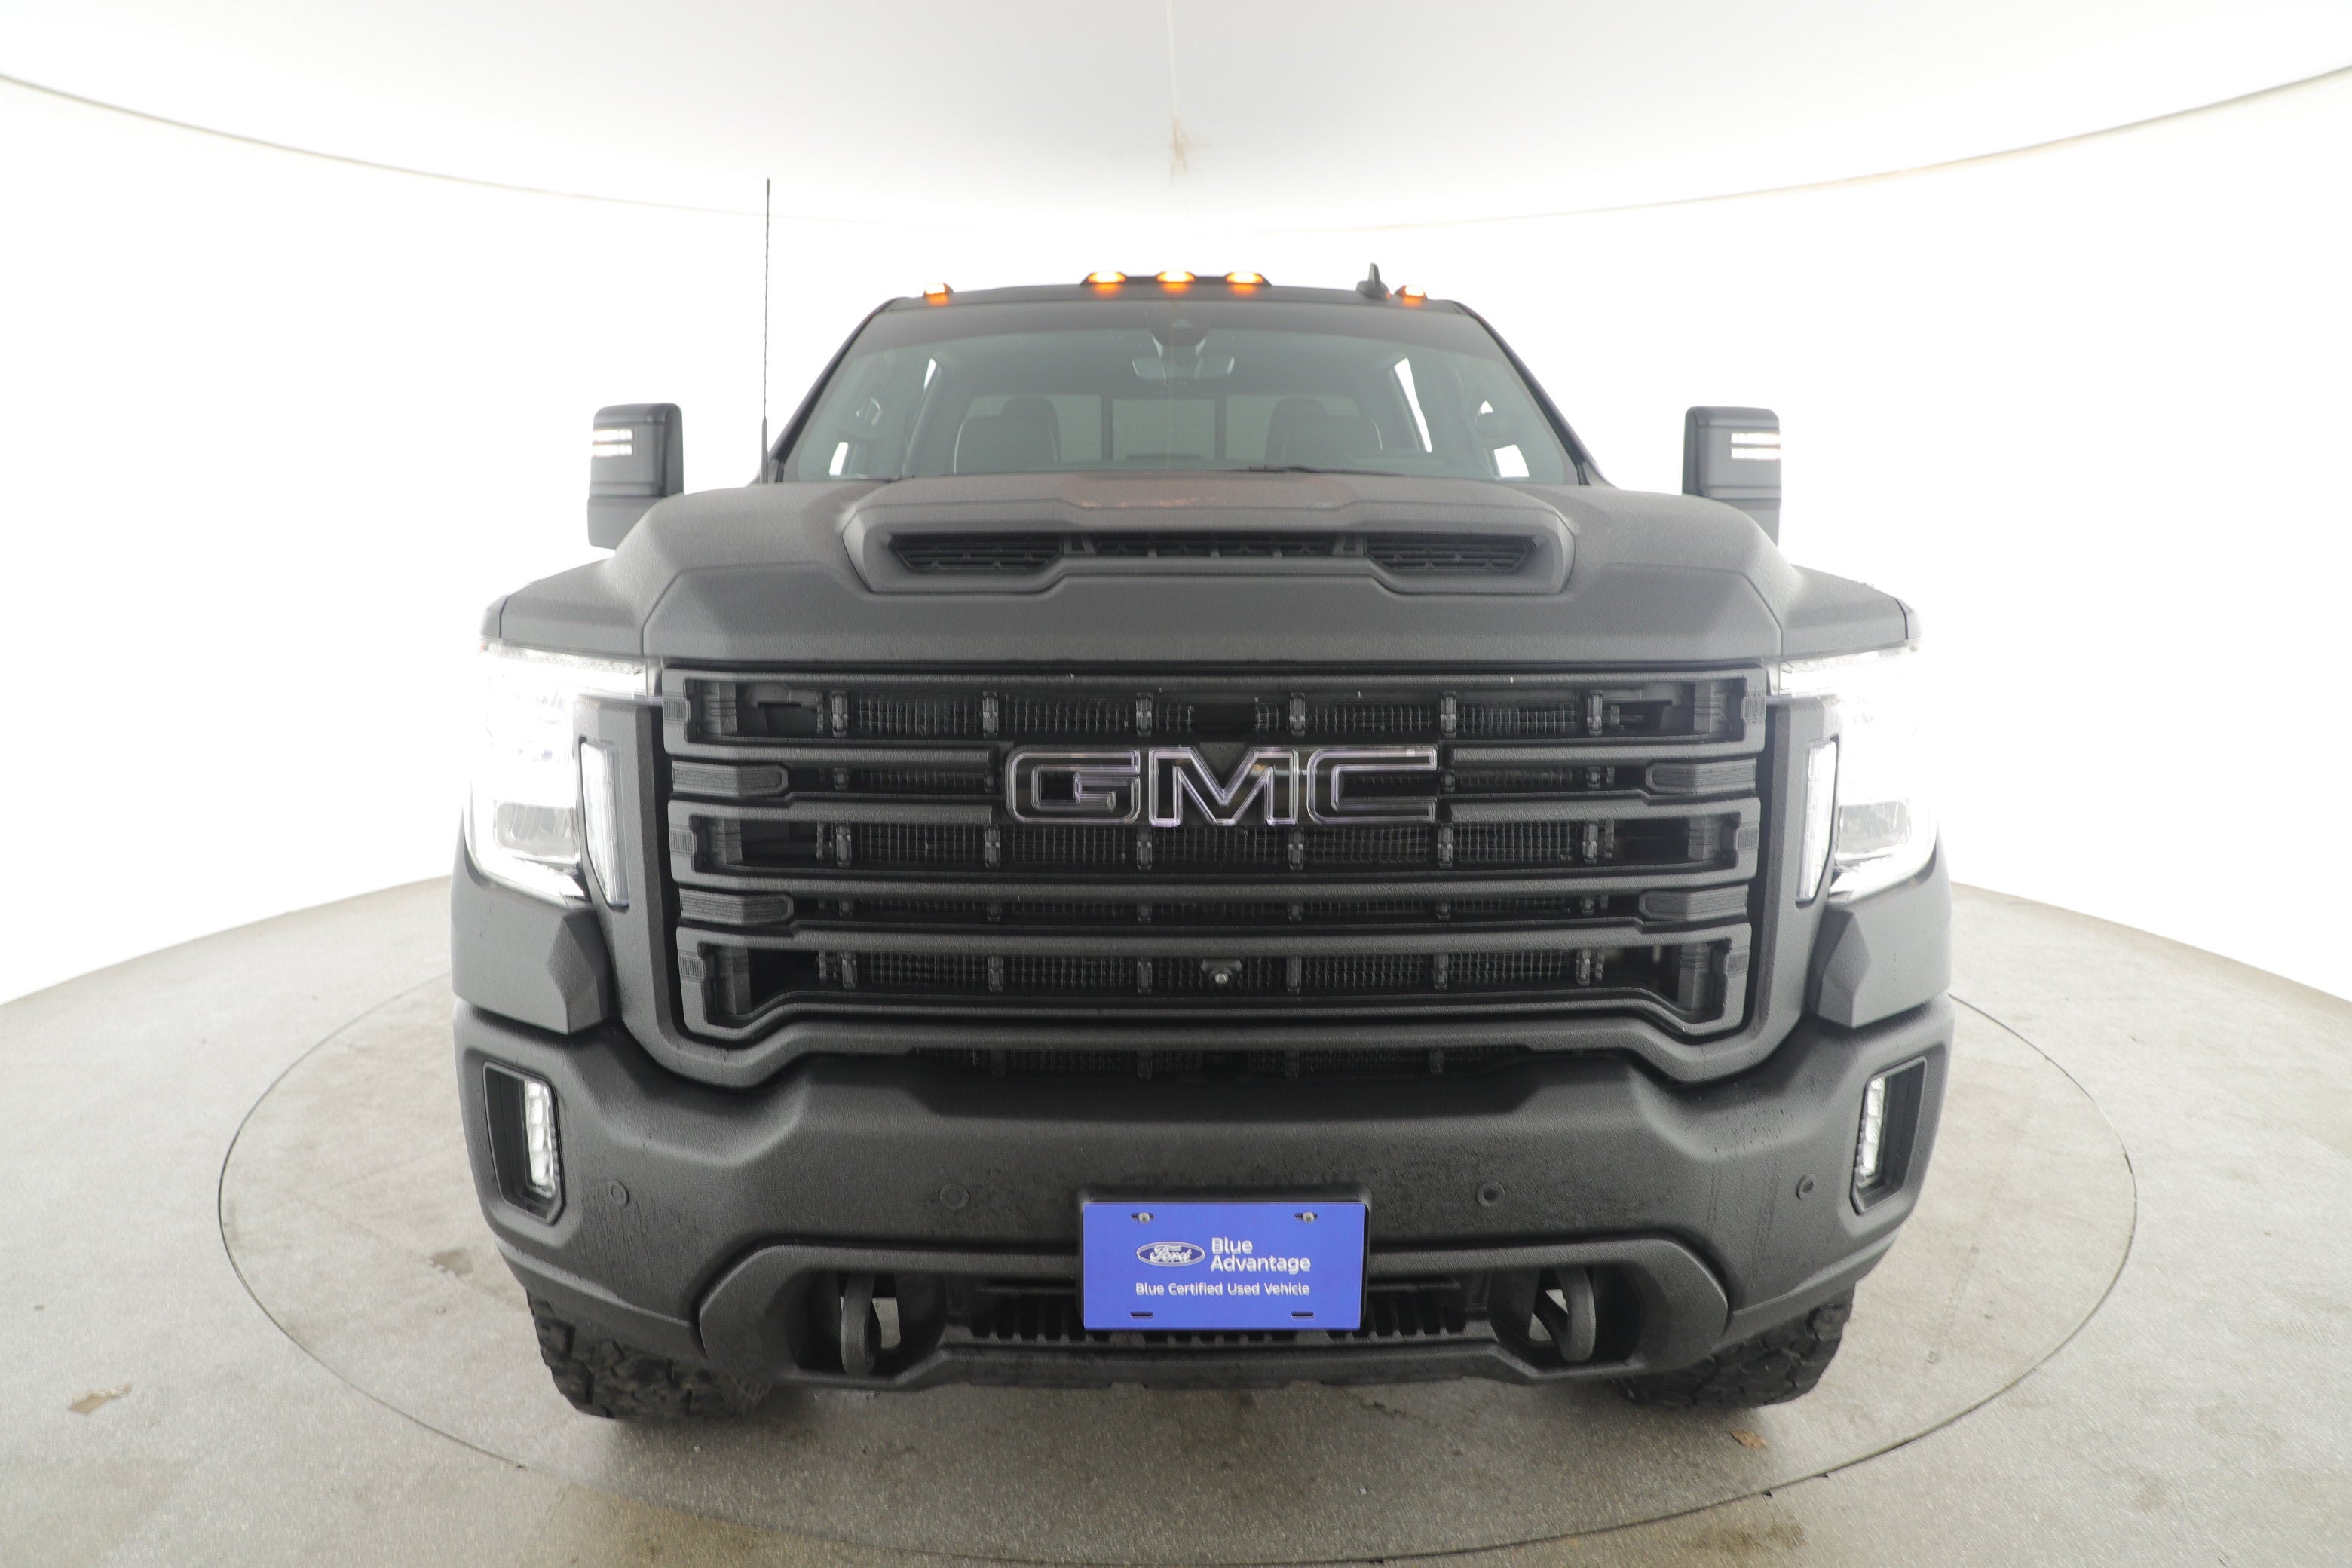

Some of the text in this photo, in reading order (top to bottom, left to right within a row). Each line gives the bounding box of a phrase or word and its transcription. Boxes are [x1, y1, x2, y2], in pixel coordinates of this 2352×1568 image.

[1006, 747, 1438, 828] GMC
[1211, 1237, 1253, 1255] Blue
[1210, 1254, 1312, 1275] Advantage
[1135, 1282, 1310, 1296] Blue Certified Used Vehicle
